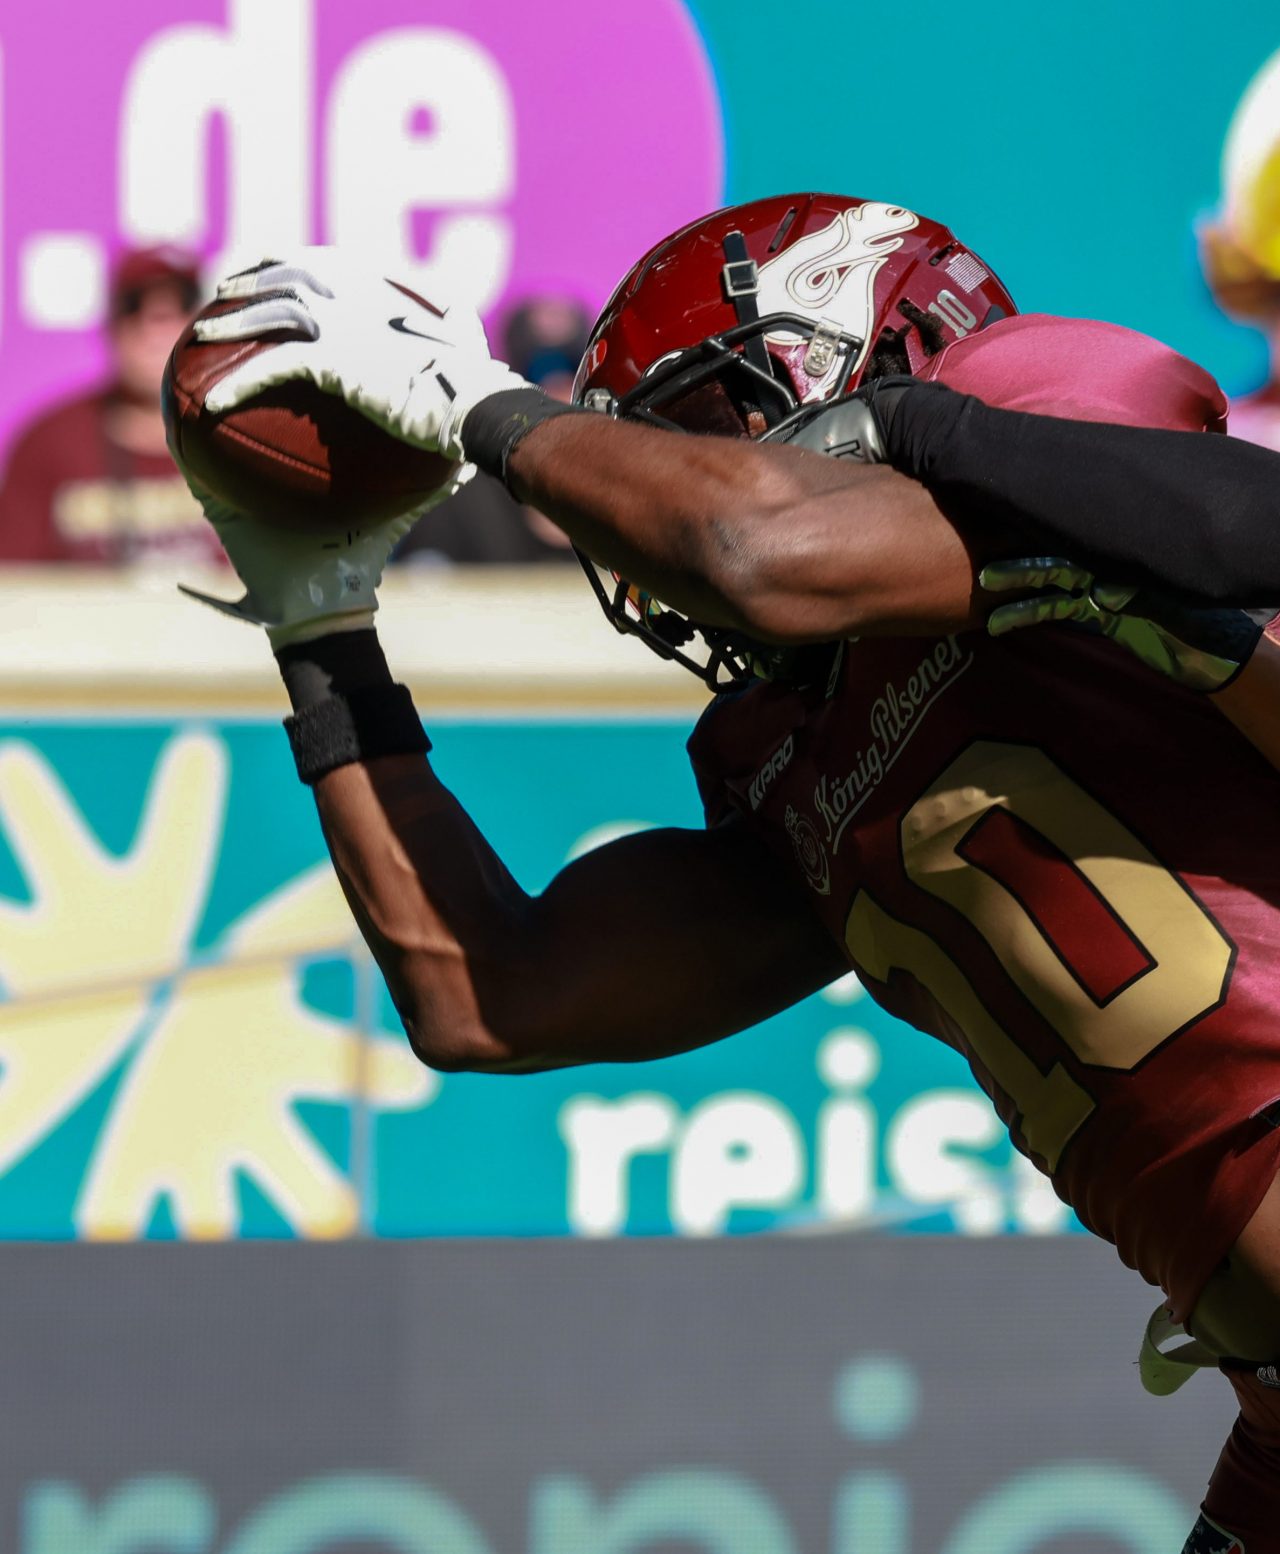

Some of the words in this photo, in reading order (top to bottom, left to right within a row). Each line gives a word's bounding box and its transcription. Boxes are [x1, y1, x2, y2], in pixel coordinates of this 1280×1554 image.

[927, 289, 977, 339] 10
[814, 742, 885, 843] König
[870, 633, 964, 762] Pilsener
[844, 738, 1238, 1175] 10
